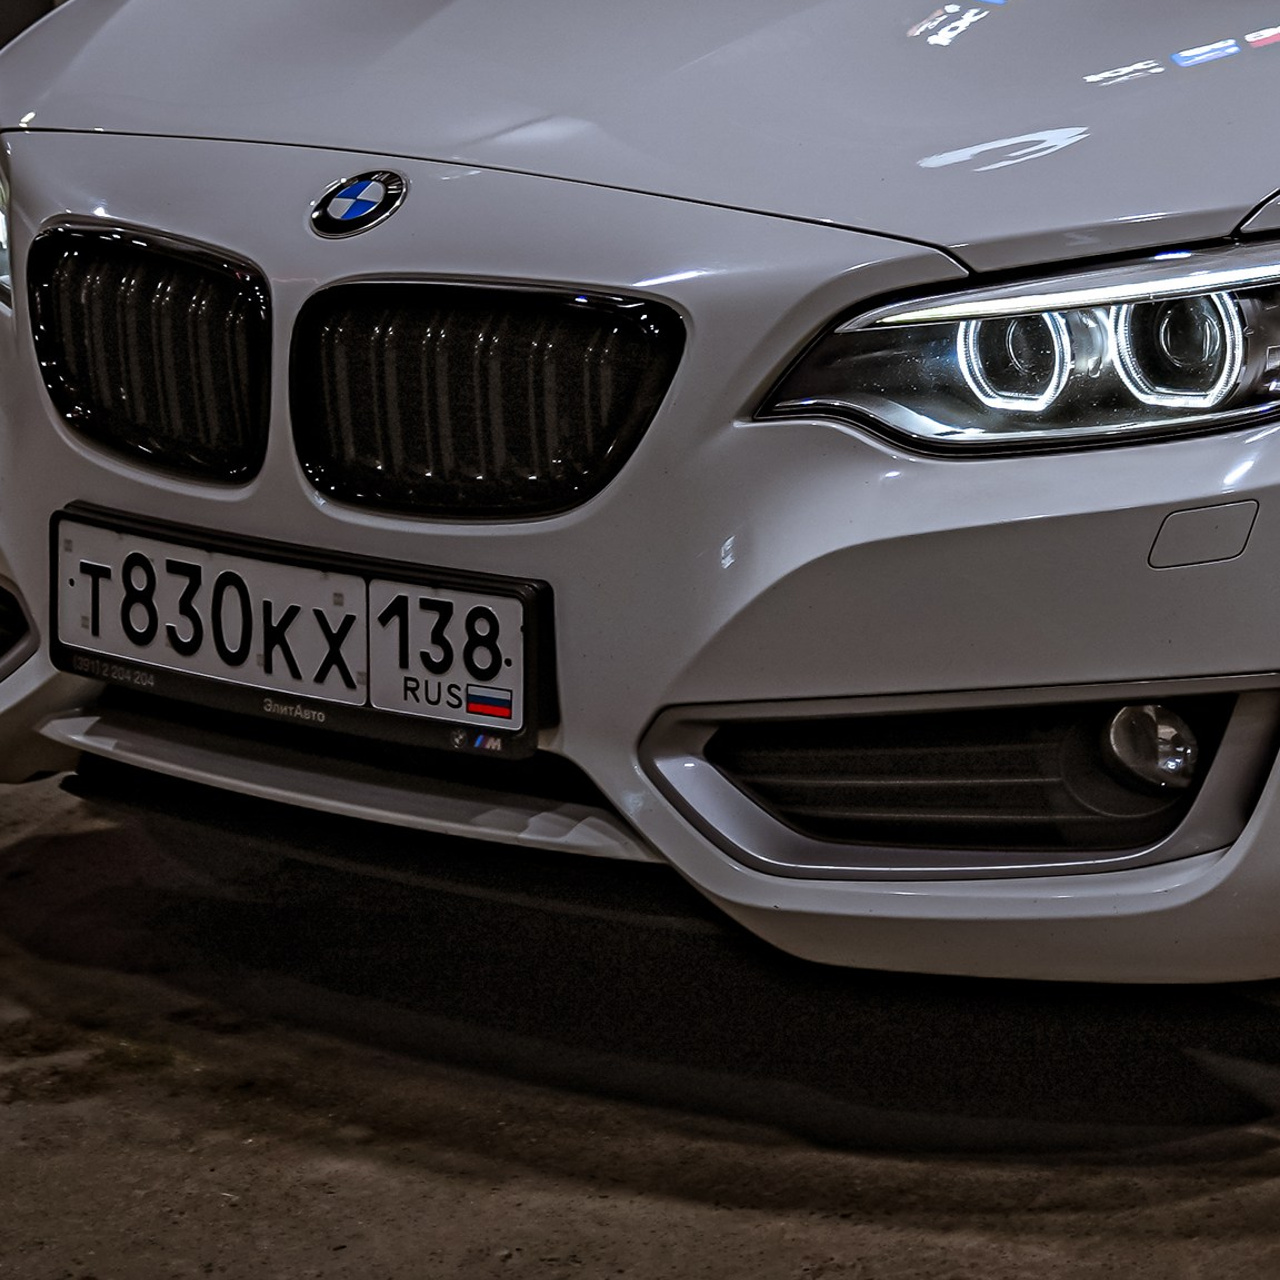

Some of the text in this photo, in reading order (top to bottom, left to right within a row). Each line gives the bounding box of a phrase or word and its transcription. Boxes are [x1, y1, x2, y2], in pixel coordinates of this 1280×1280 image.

[377, 594, 503, 682] 138
[263, 697, 326, 722] ЭлитАвто
[402, 676, 464, 710] RUS
